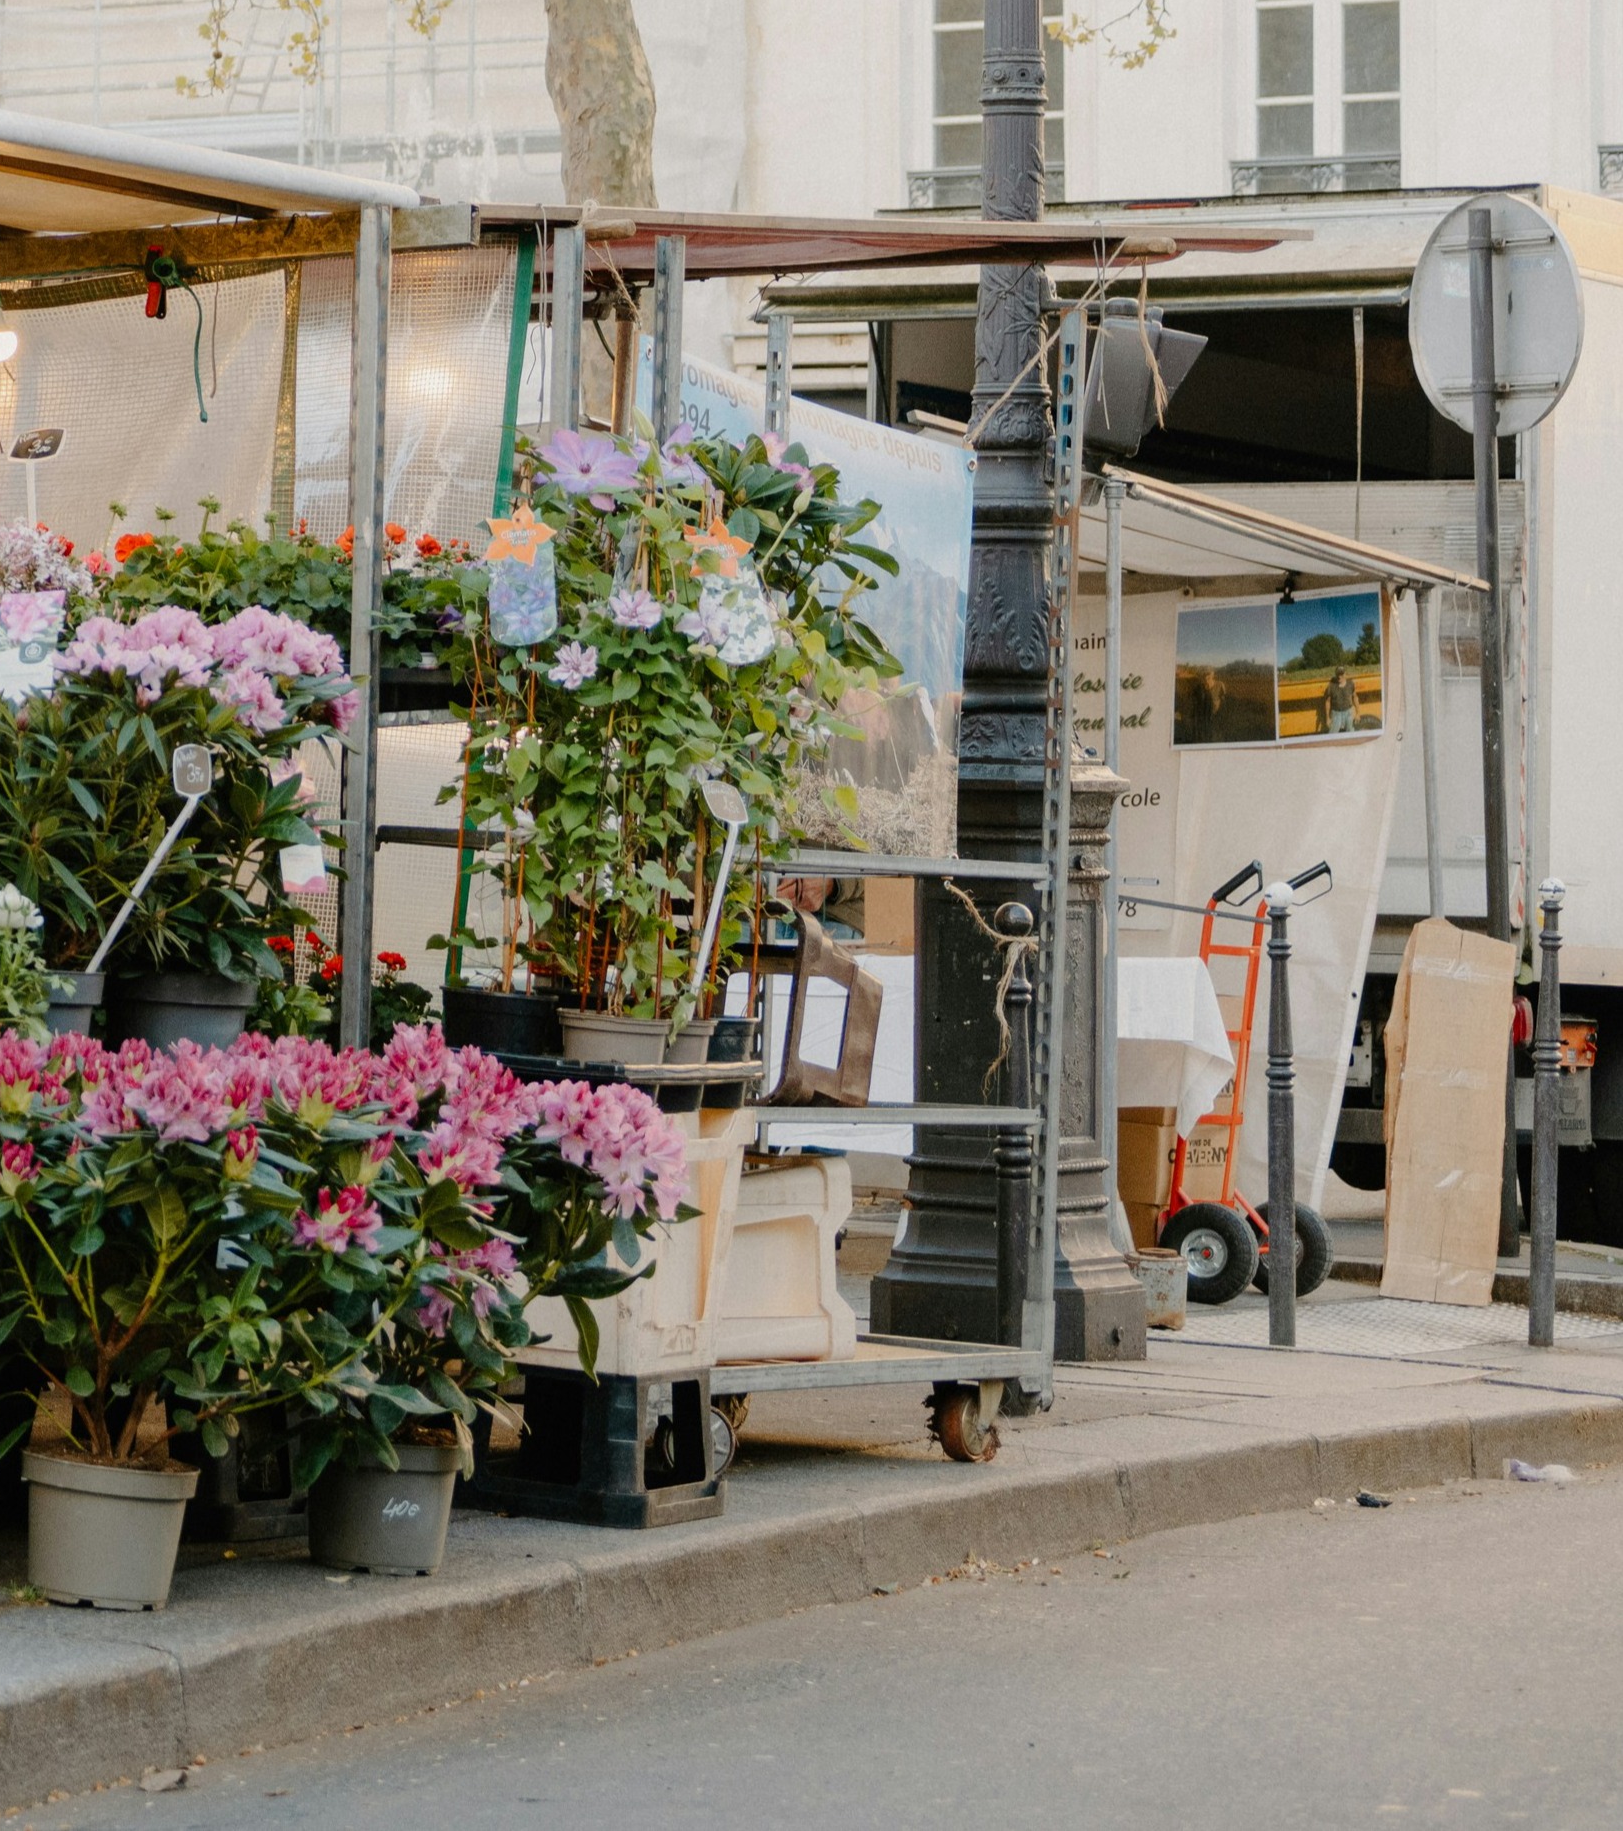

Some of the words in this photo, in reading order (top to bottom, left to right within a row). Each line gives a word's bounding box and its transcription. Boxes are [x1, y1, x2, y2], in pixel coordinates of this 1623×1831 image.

[681, 362, 758, 408] romages
[883, 428, 941, 473] depuis
[1203, 1139, 1212, 1147] DE
